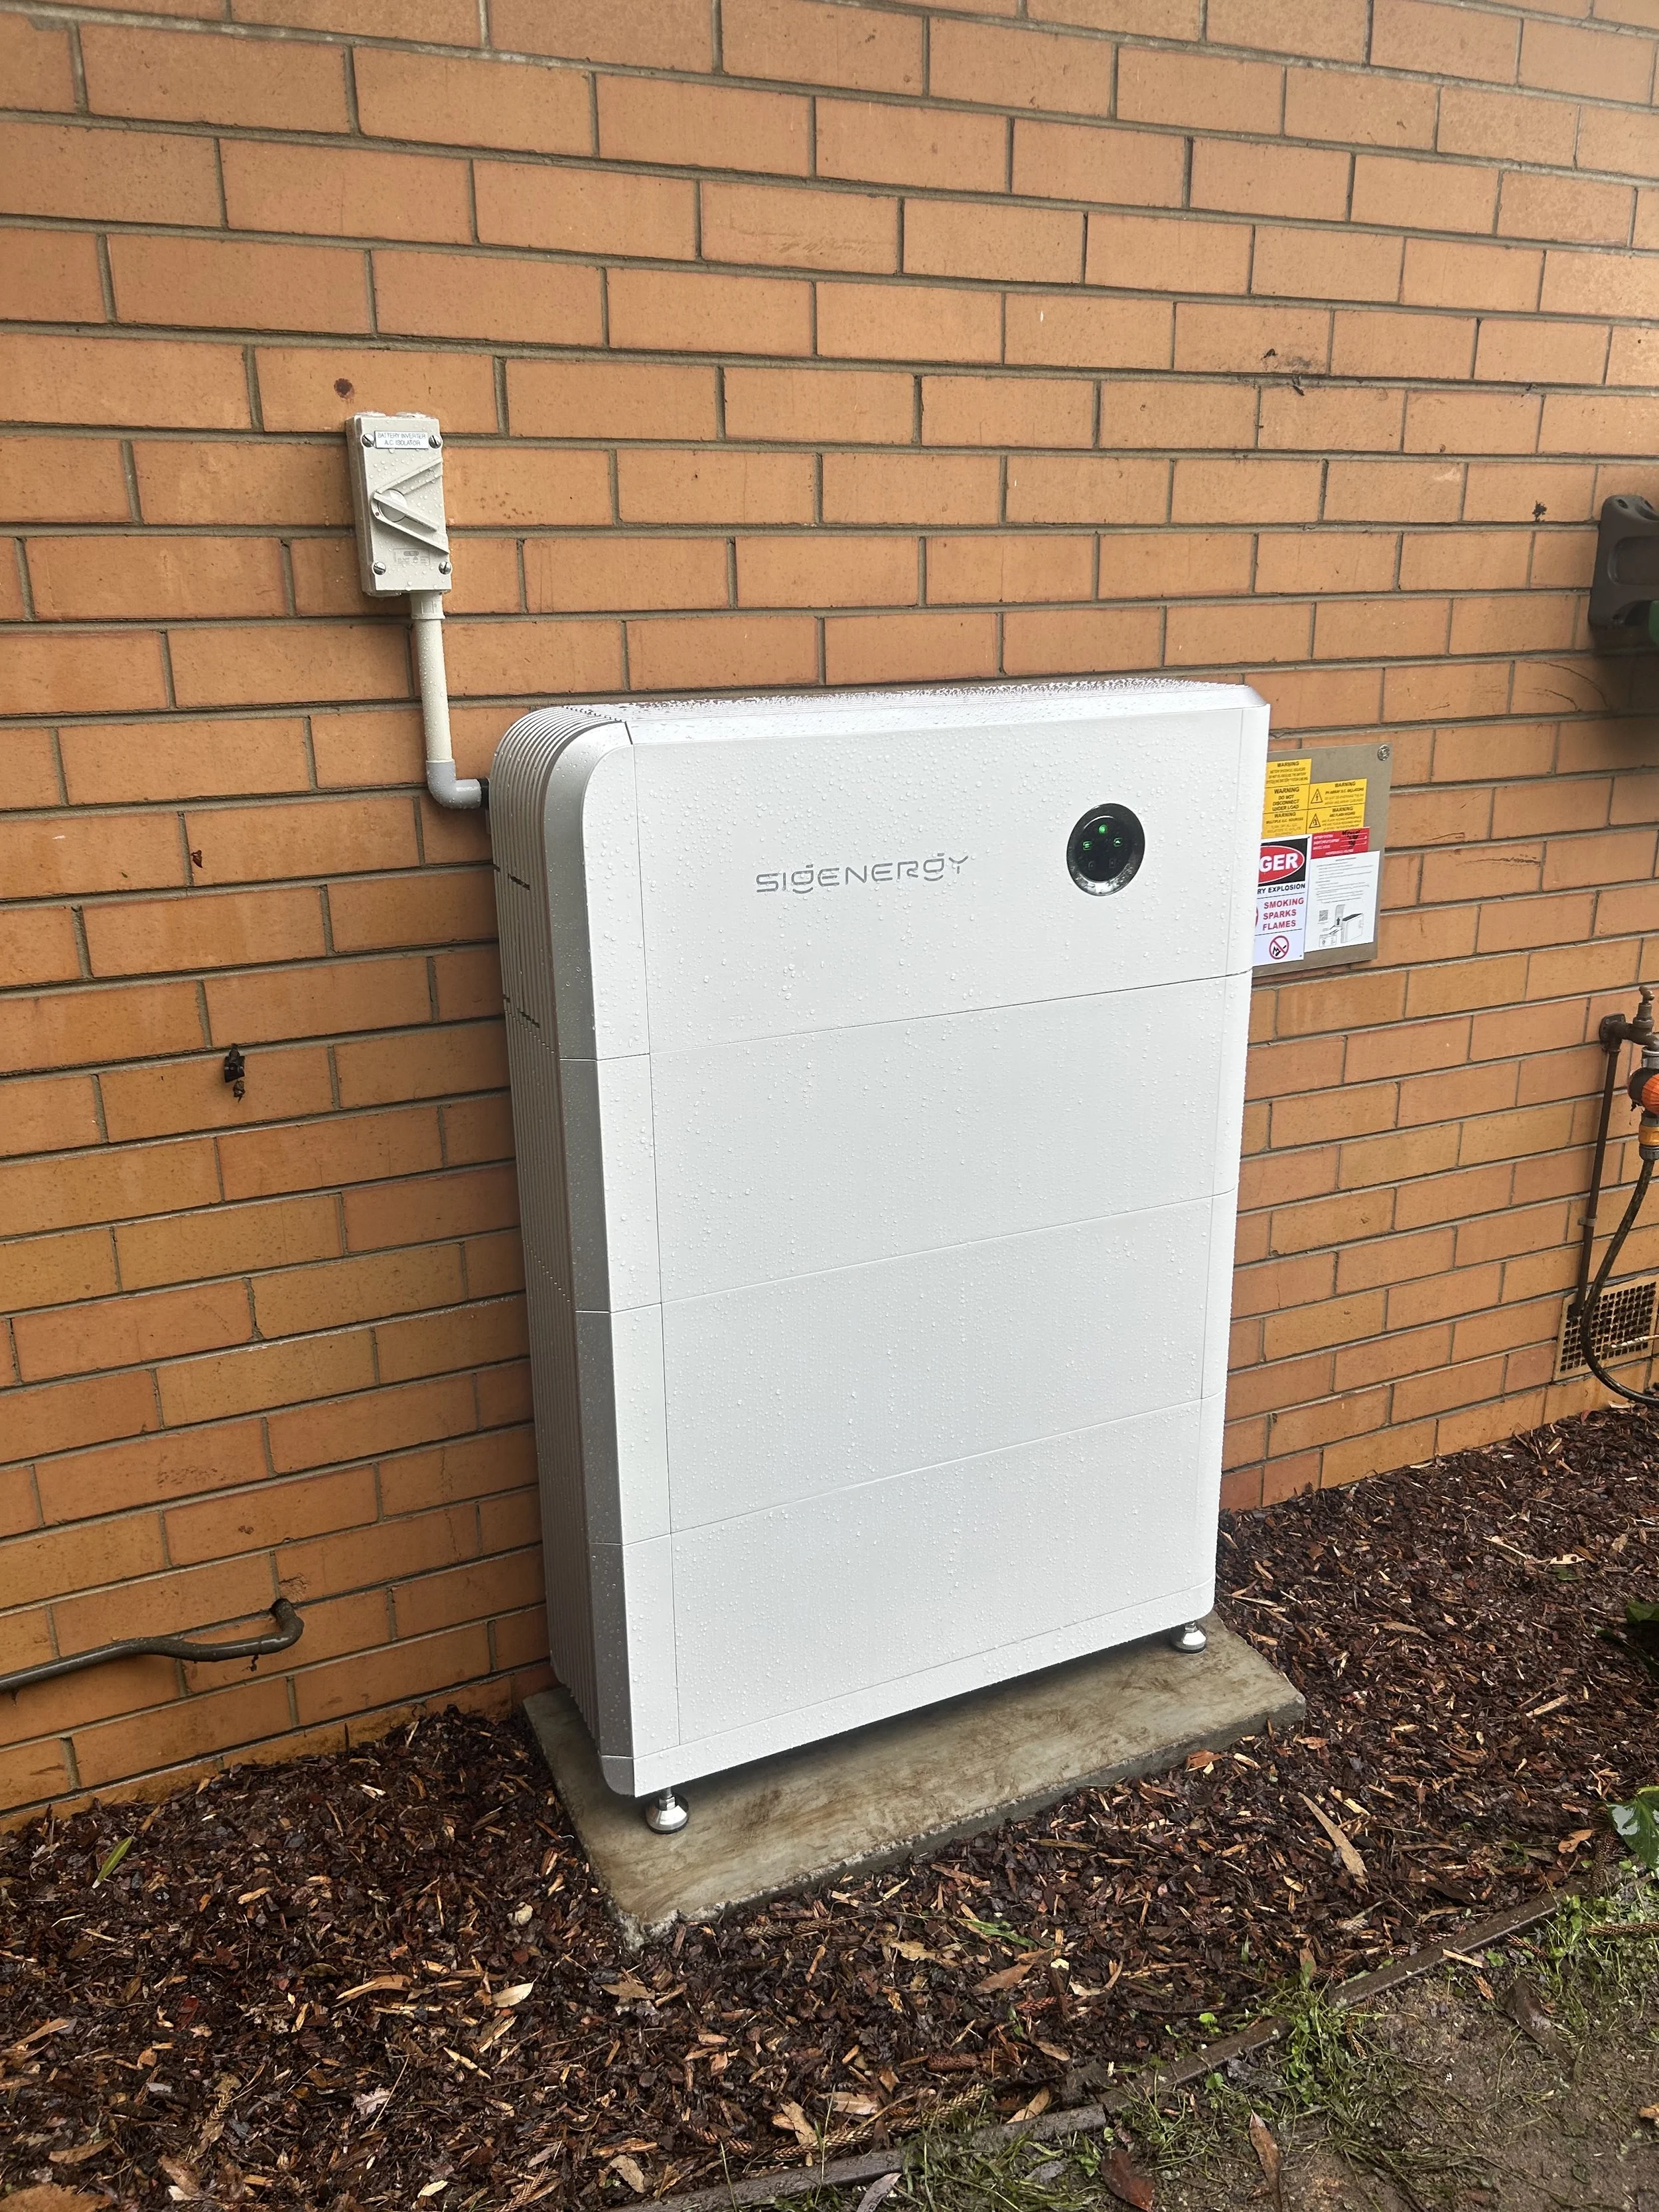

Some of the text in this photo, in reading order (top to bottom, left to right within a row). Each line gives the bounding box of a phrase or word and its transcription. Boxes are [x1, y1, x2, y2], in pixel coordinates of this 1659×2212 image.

[1259, 852, 1299, 873] GER
[1268, 883, 1306, 893] EXPLOSION
[1263, 897, 1305, 909] SMOKING
[1263, 909, 1297, 920] SPARKS
[1262, 920, 1296, 930] FLAMES
